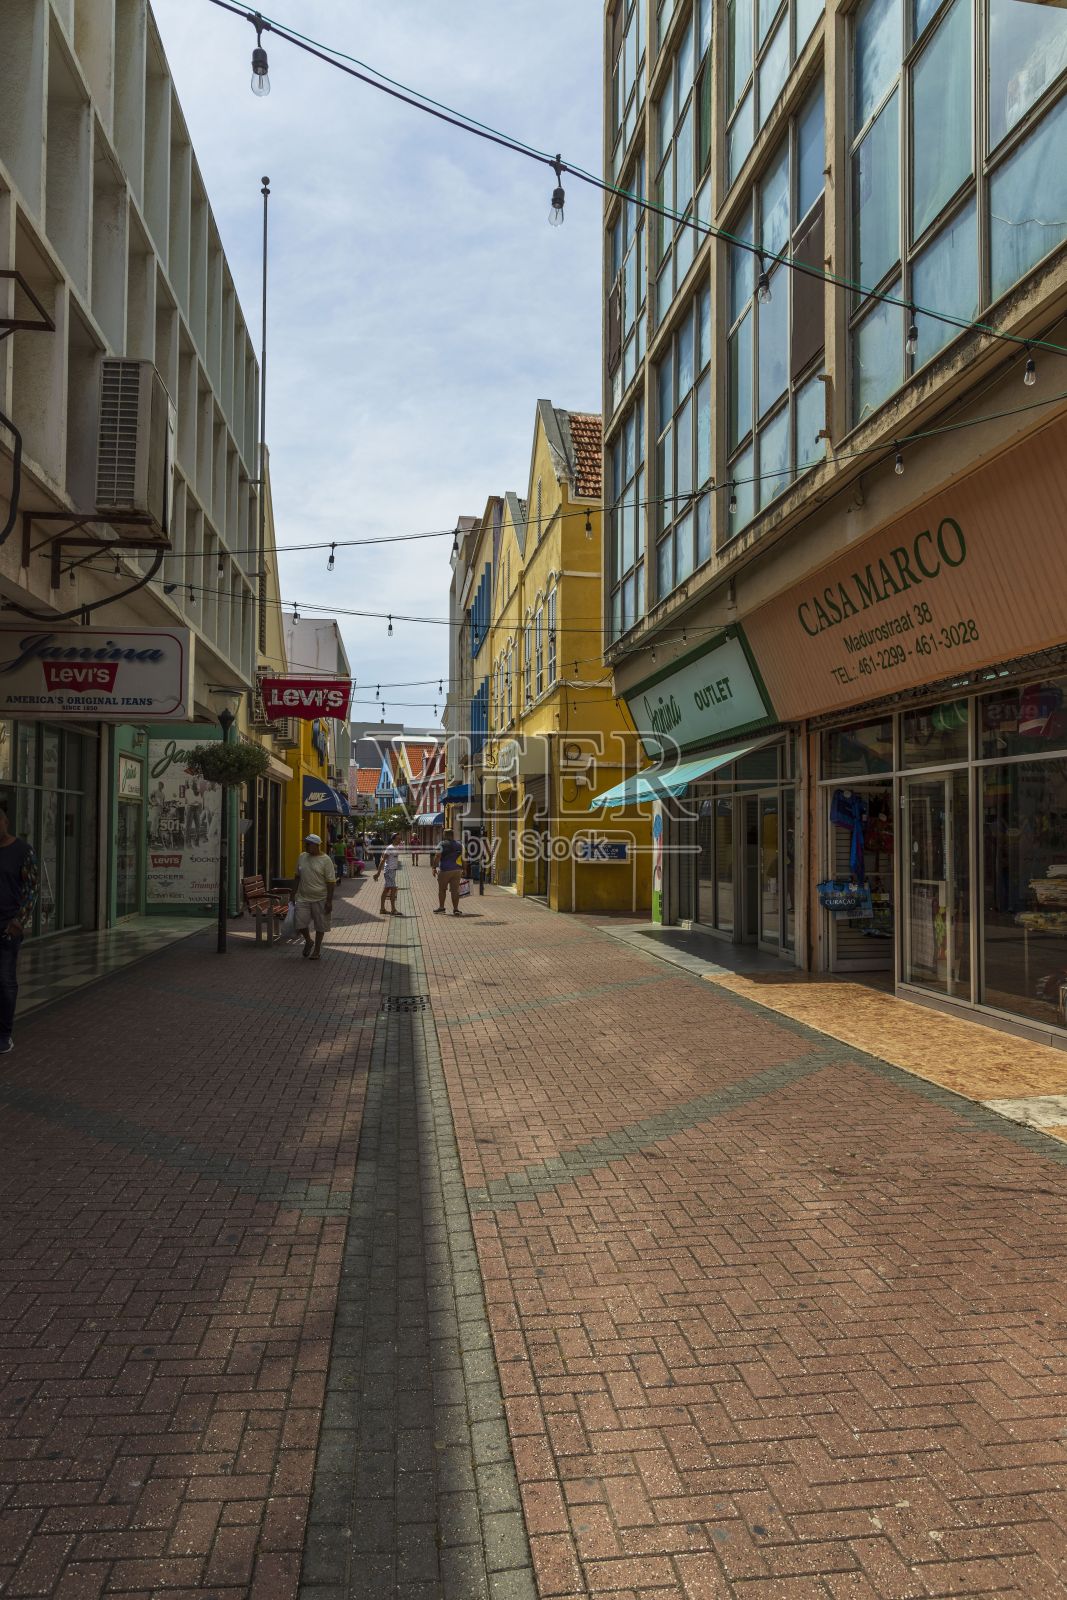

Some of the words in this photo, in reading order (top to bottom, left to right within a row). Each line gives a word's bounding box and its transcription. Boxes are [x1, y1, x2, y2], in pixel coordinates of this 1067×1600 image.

[798, 583, 859, 637] CASA
[851, 517, 967, 610] MARCO
[843, 612, 914, 654] Madurostraat
[913, 602, 933, 625] 38
[858, 644, 906, 676] 461-2299
[915, 619, 980, 656] 461-3028
[6, 695, 64, 704] AMERICA'S
[67, 697, 119, 705] ORIGINAL
[121, 698, 153, 706] JEANS
[693, 676, 734, 711] OUTLET
[308, 791, 327, 801] NIKE
